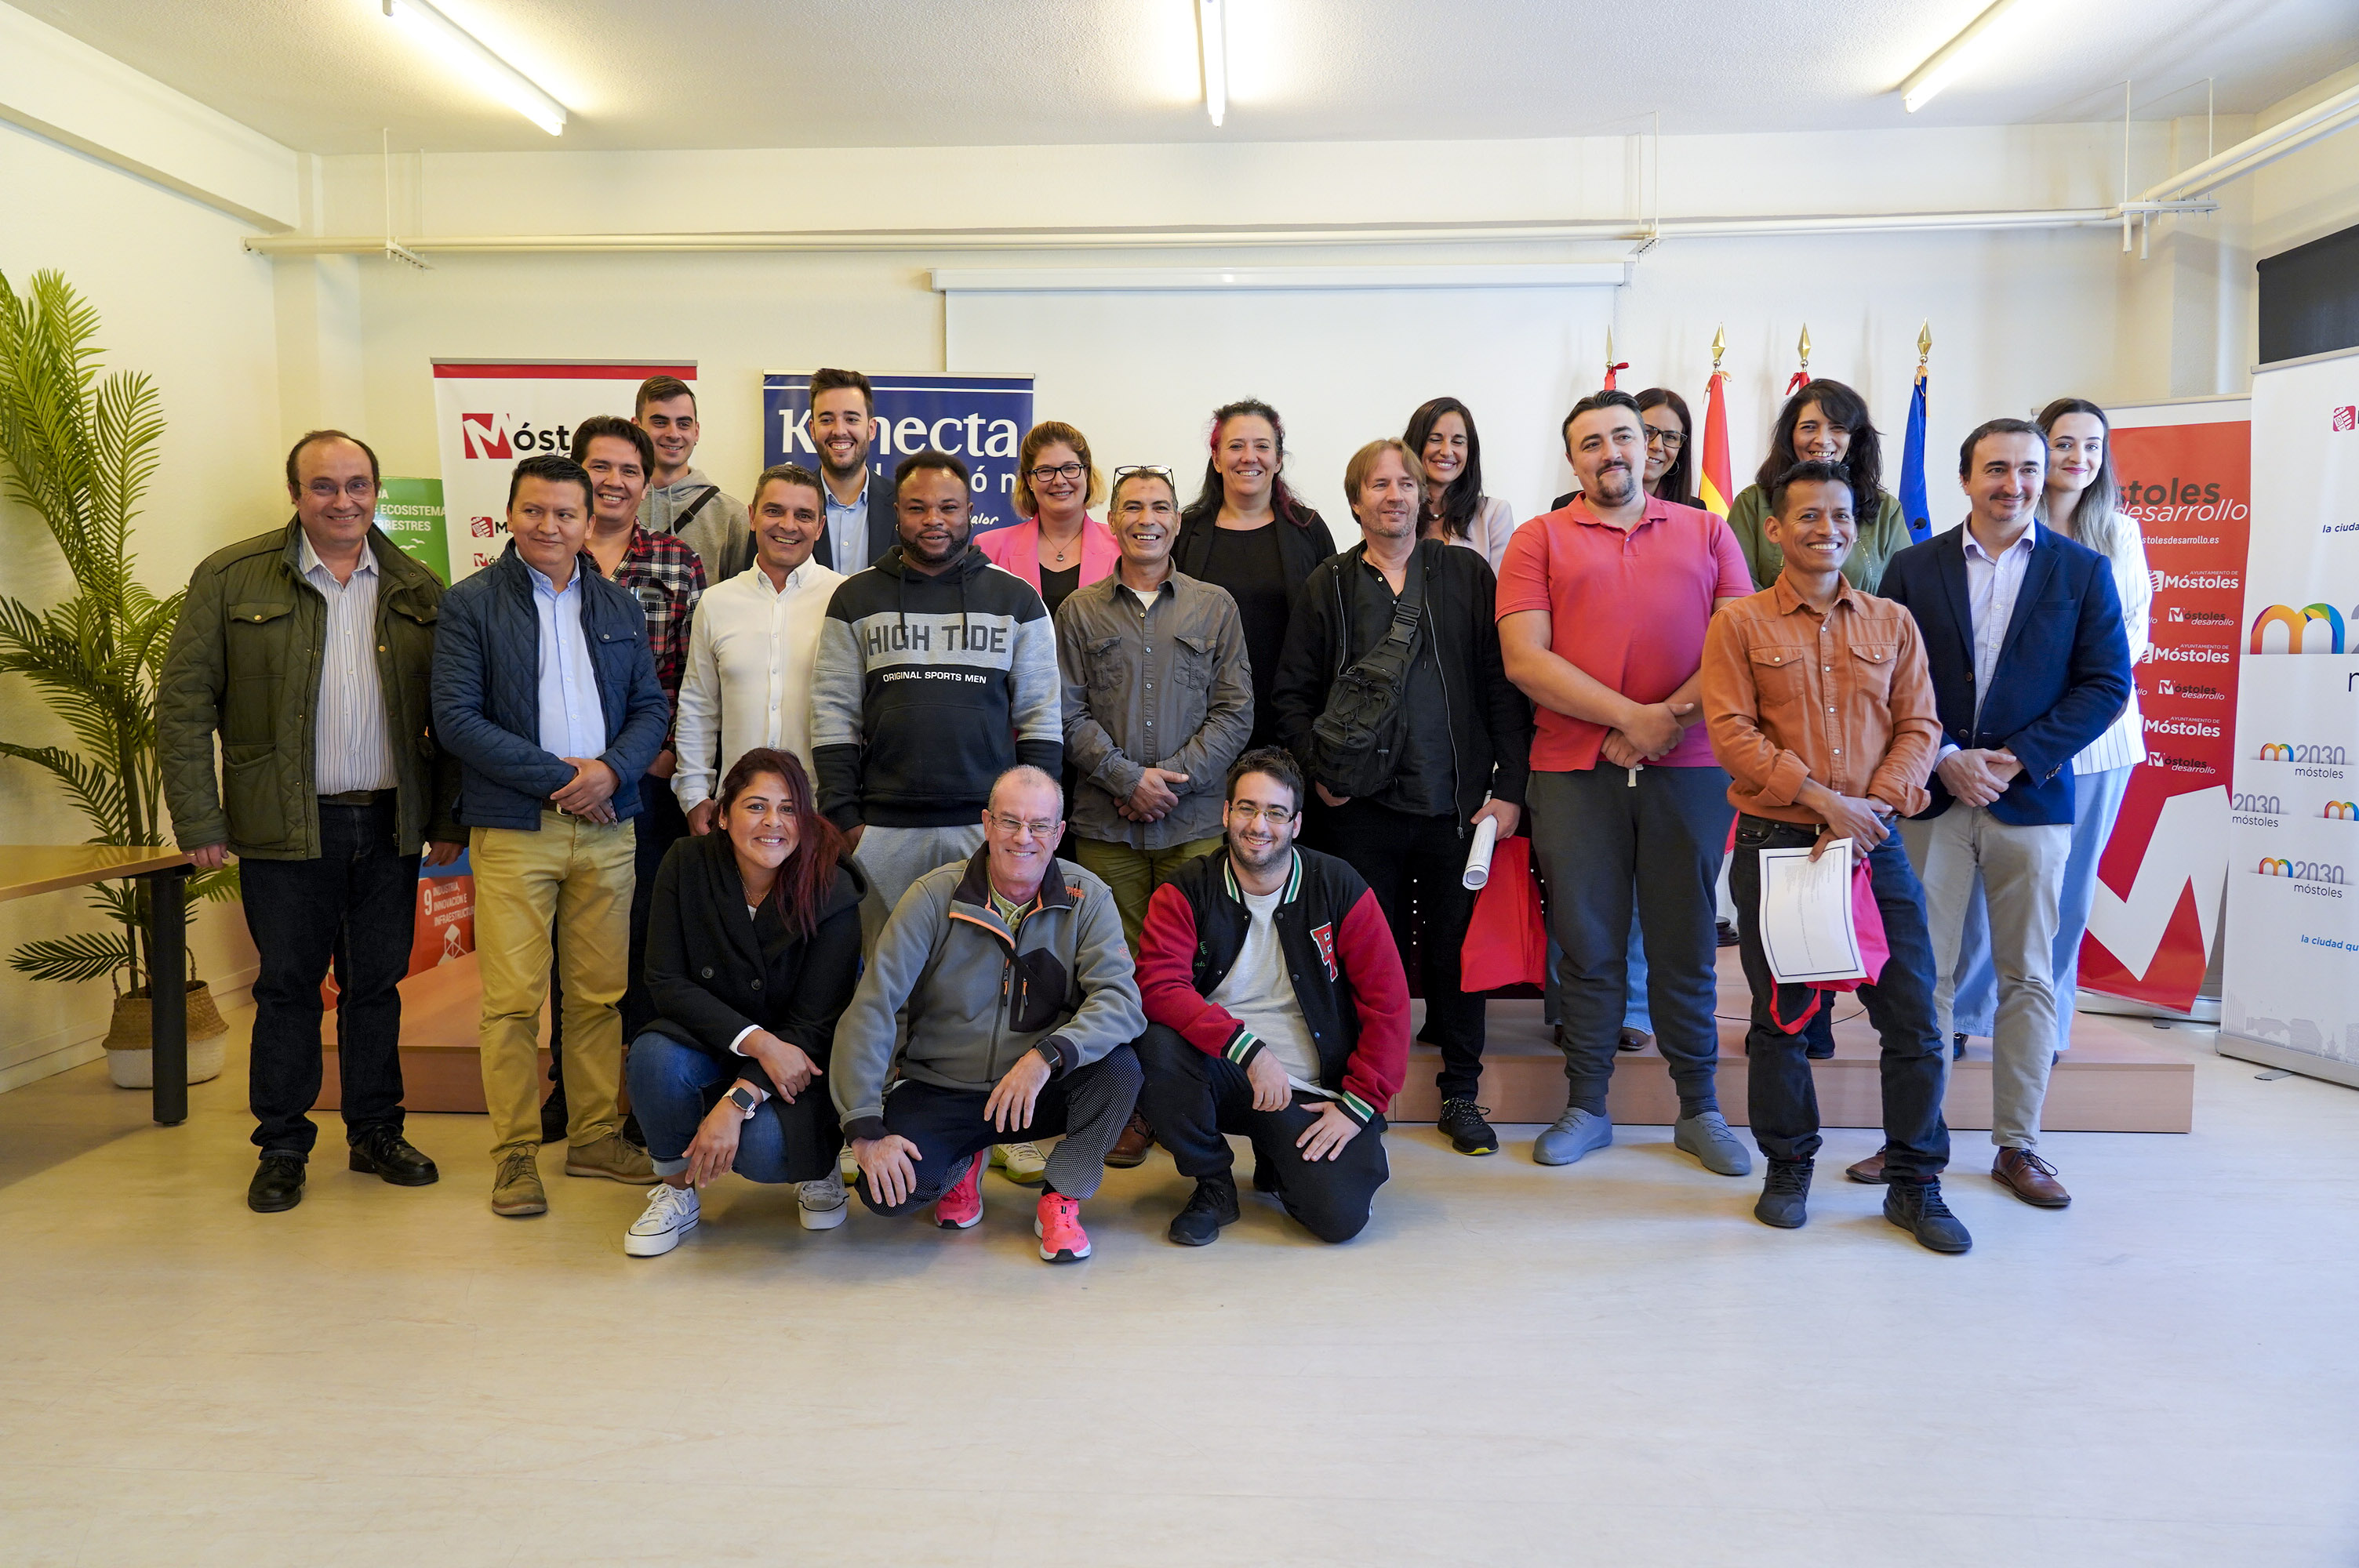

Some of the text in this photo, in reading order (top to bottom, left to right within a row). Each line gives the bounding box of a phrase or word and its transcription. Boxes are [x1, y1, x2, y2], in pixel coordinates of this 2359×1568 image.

[779, 409, 1018, 457] Knecta
[380, 504, 445, 516] ECOSISTEMA
[969, 513, 999, 524] alor
[2322, 522, 2359, 533] la ciuda
[2142, 535, 2219, 545] stolesdesarrollo.es
[2165, 575, 2239, 589] Móstoles
[867, 624, 1008, 656] HIGH TIDE
[2154, 648, 2230, 663] Móstoles
[882, 671, 987, 684] ORIGINAL SPORTS MEN
[2182, 691, 2226, 700] desarrollo
[2144, 720, 2220, 737] Móstoles
[2172, 764, 2216, 775] desarrollo
[2295, 767, 2344, 779] móstoles
[2234, 793, 2281, 815] 2030
[2232, 815, 2279, 828] móstoles
[2294, 884, 2343, 898] móstoles
[423, 889, 433, 916] 9
[463, 893, 467, 903] E
[2301, 934, 2359, 953] la ciudad qu
